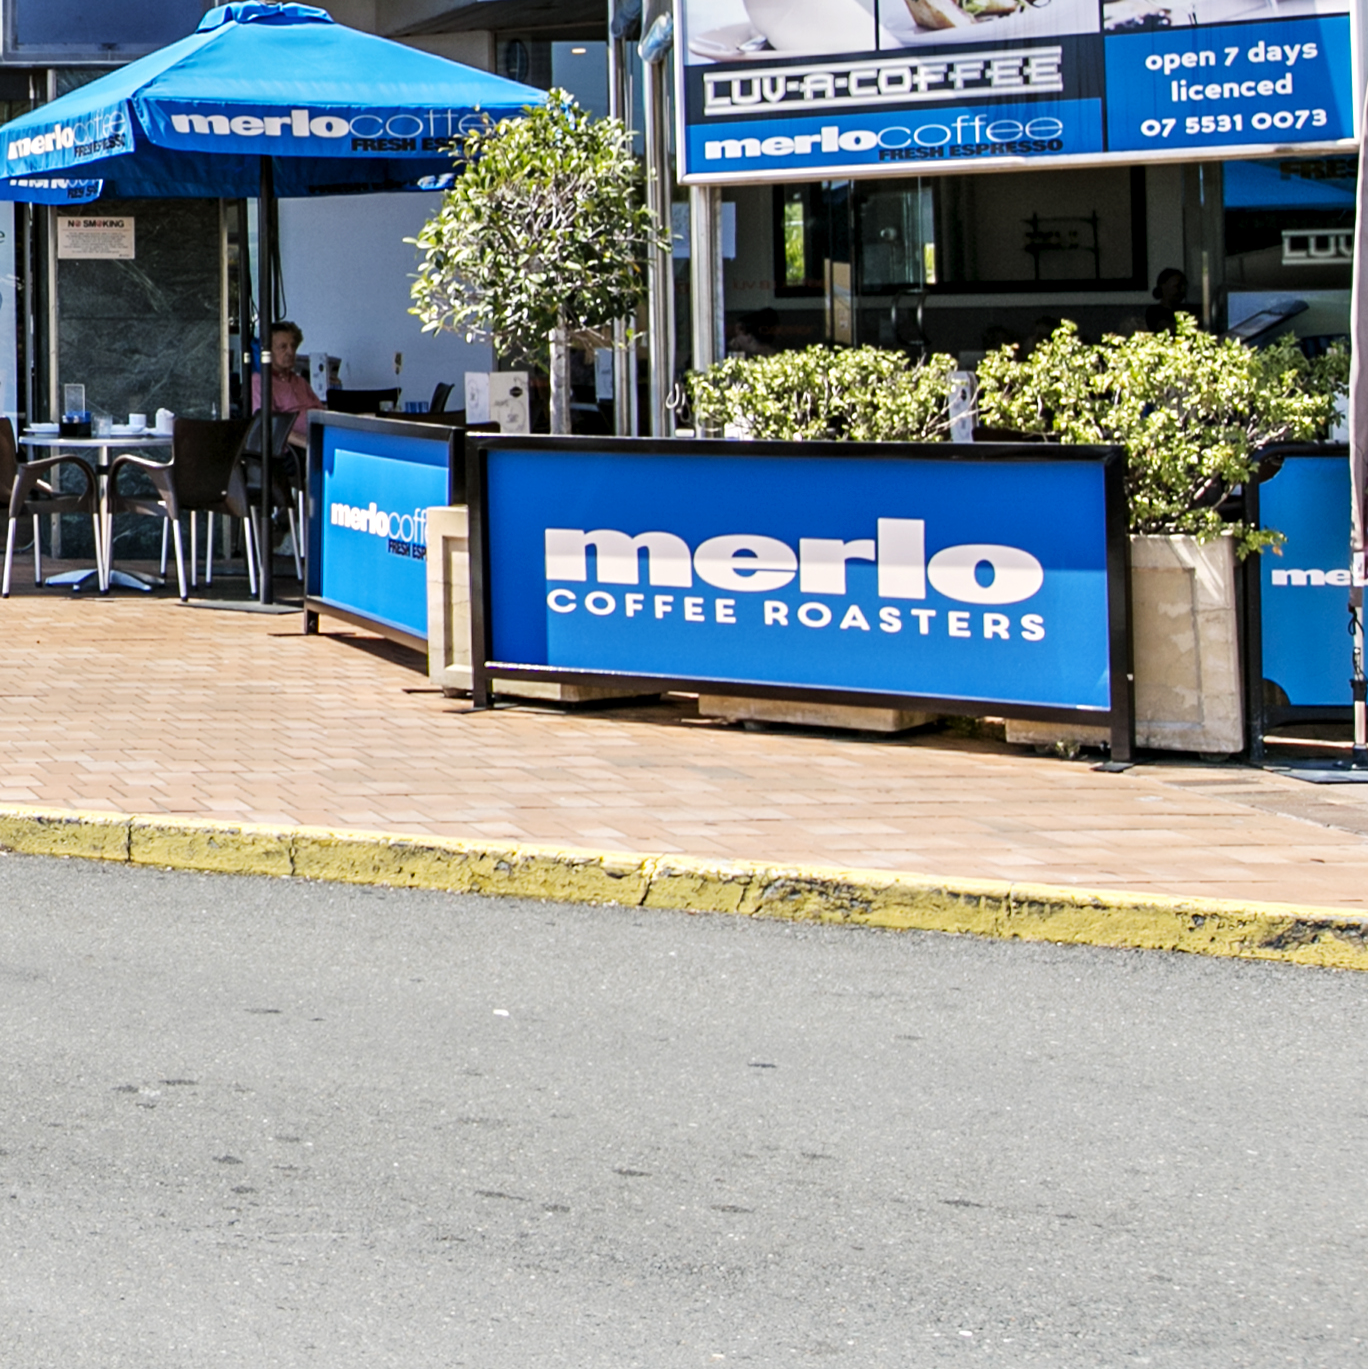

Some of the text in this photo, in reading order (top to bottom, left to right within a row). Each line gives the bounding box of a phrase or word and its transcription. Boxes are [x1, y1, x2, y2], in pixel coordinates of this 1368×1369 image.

[1145, 41, 1318, 75] open 7 days
[1171, 73, 1293, 102] licenced
[171, 109, 530, 138] merlocoffe
[704, 114, 1063, 160] merlocoffee
[1140, 109, 1327, 138] 07 5531 0073
[351, 138, 416, 151] FRESH
[878, 139, 1064, 161] FRESH ESPRESSO
[331, 502, 428, 543] merlocoff
[388, 538, 411, 556] FRESH
[545, 517, 1044, 605] merlo
[546, 588, 1046, 642] COFFEE ROASTERS
